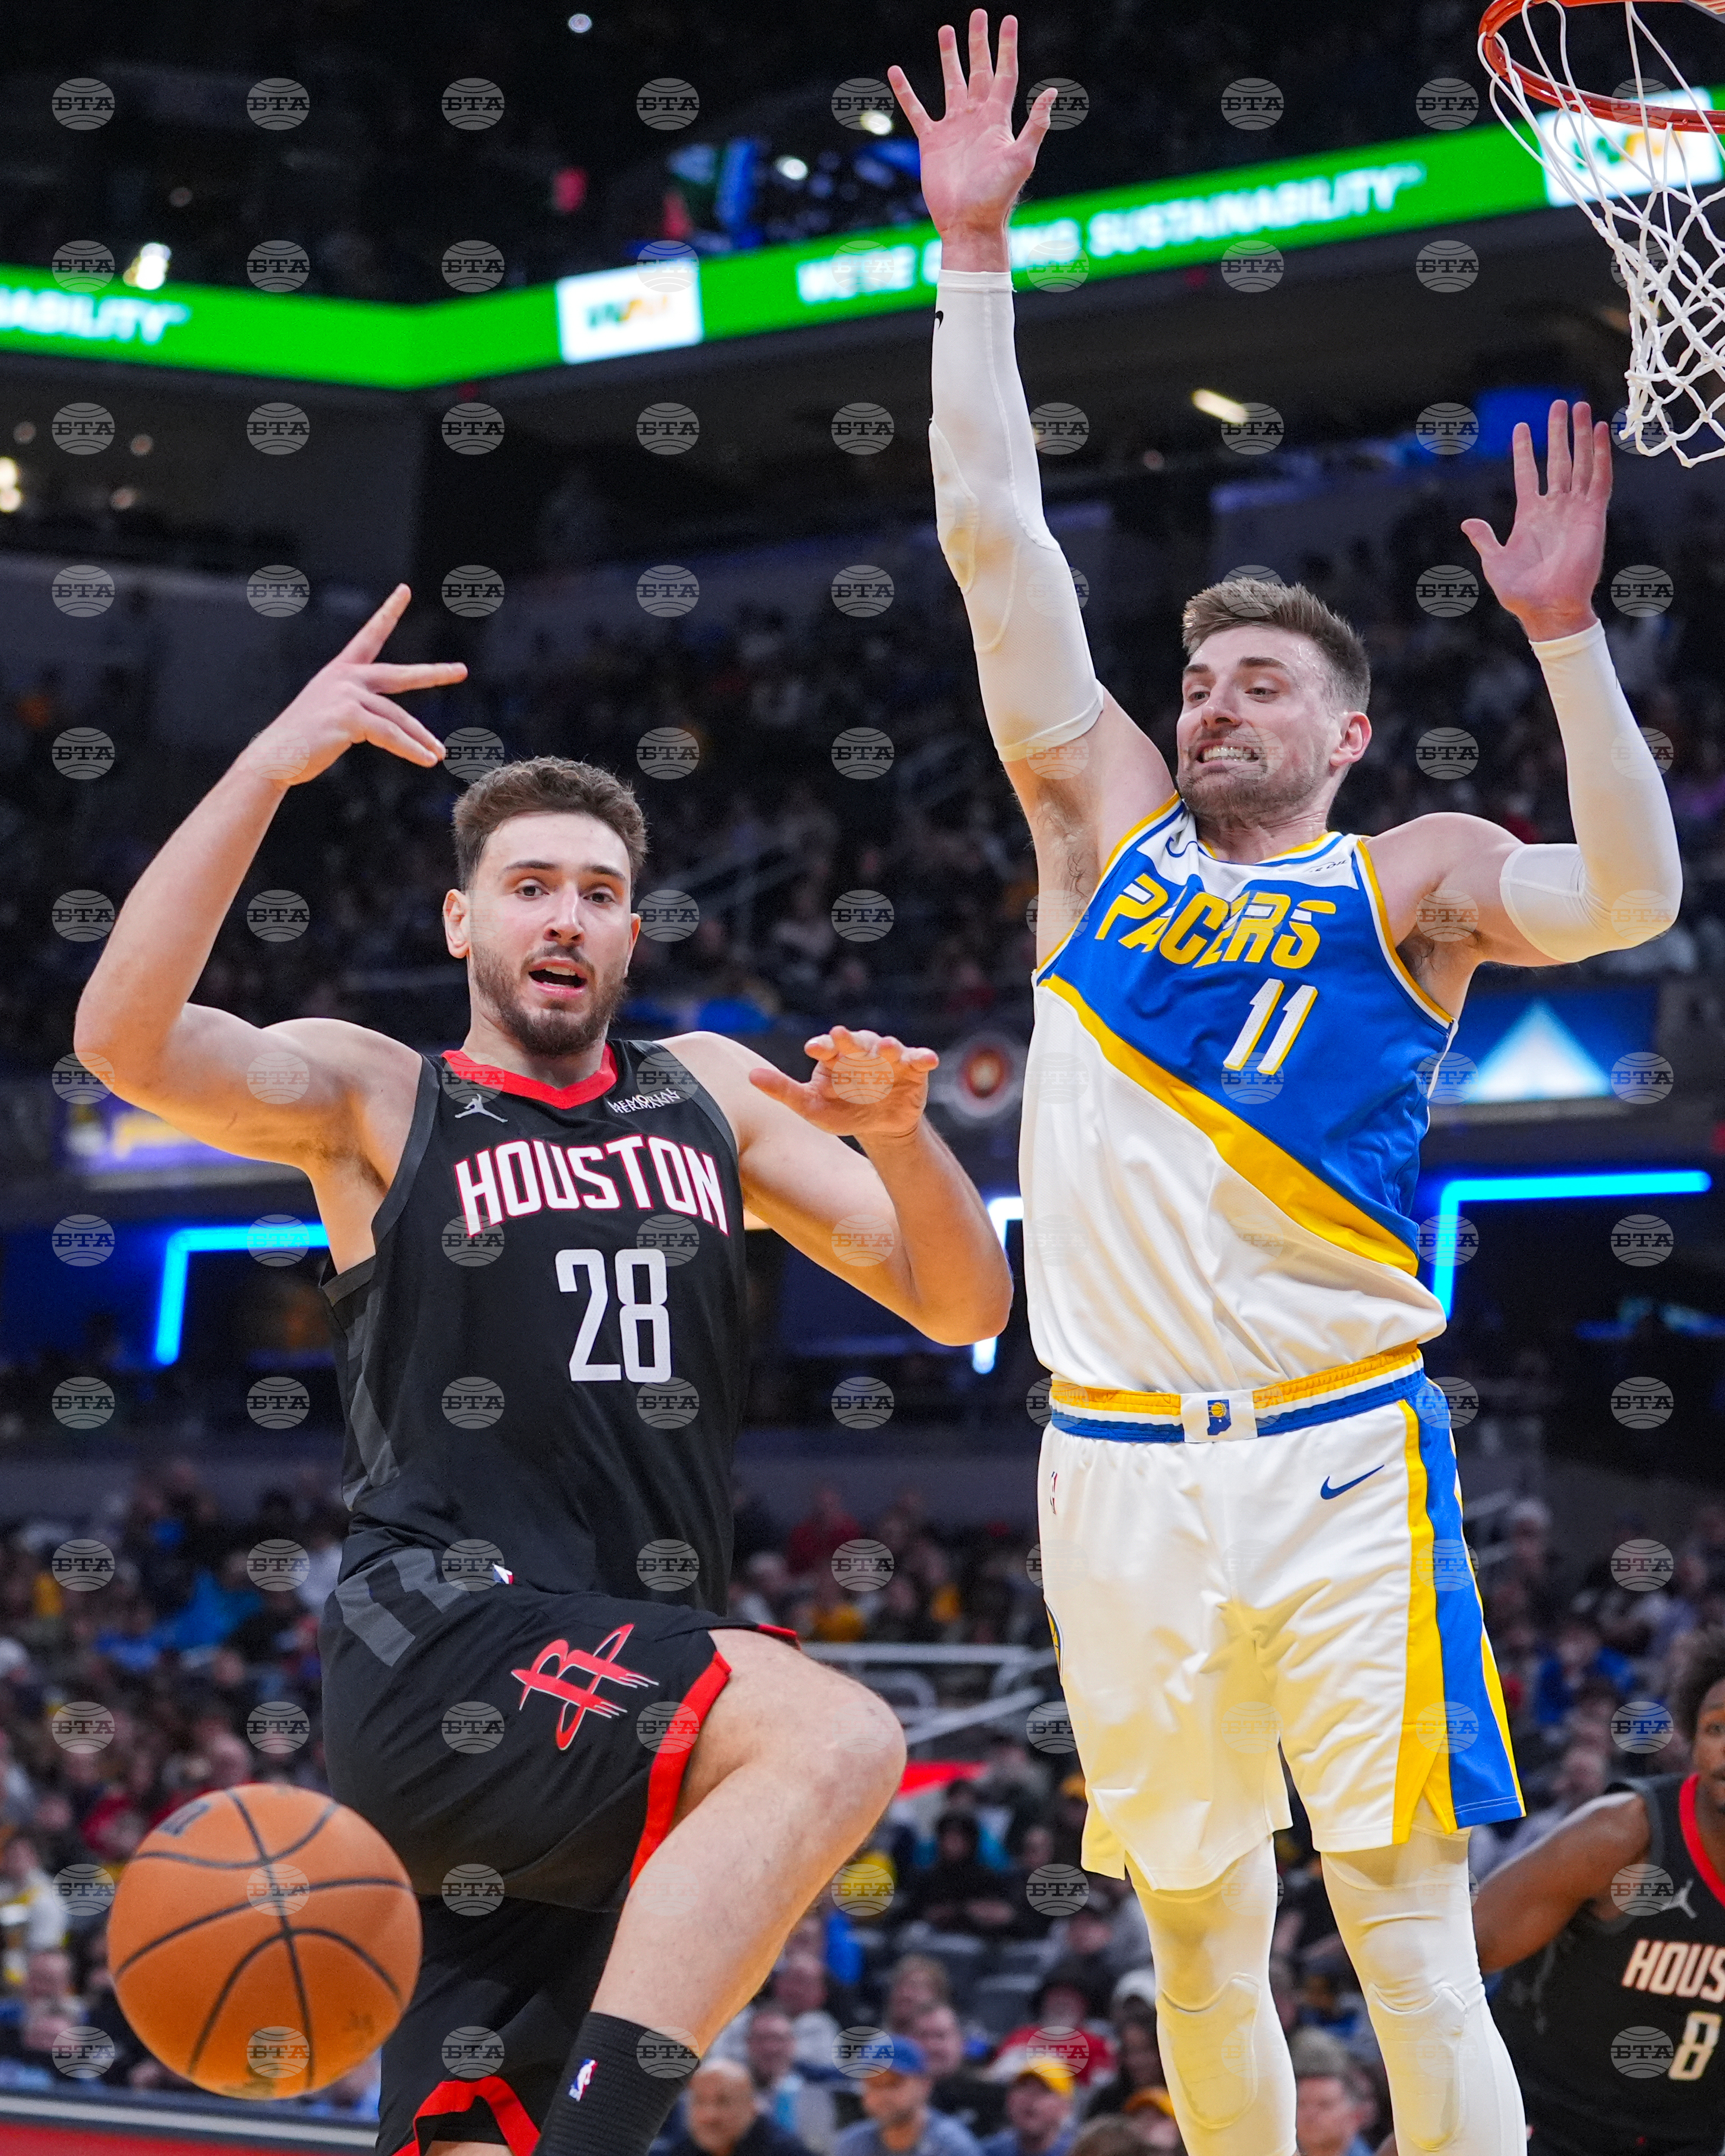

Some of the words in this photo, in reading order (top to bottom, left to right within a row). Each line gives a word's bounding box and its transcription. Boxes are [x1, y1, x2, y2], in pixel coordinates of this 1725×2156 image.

[1095, 873, 1336, 969] PACERS
[1223, 978, 1318, 1075] 11
[454, 1134, 729, 1238] HOUSTON
[555, 1248, 671, 1383] 28
[1668, 2011, 1722, 2081] 8
